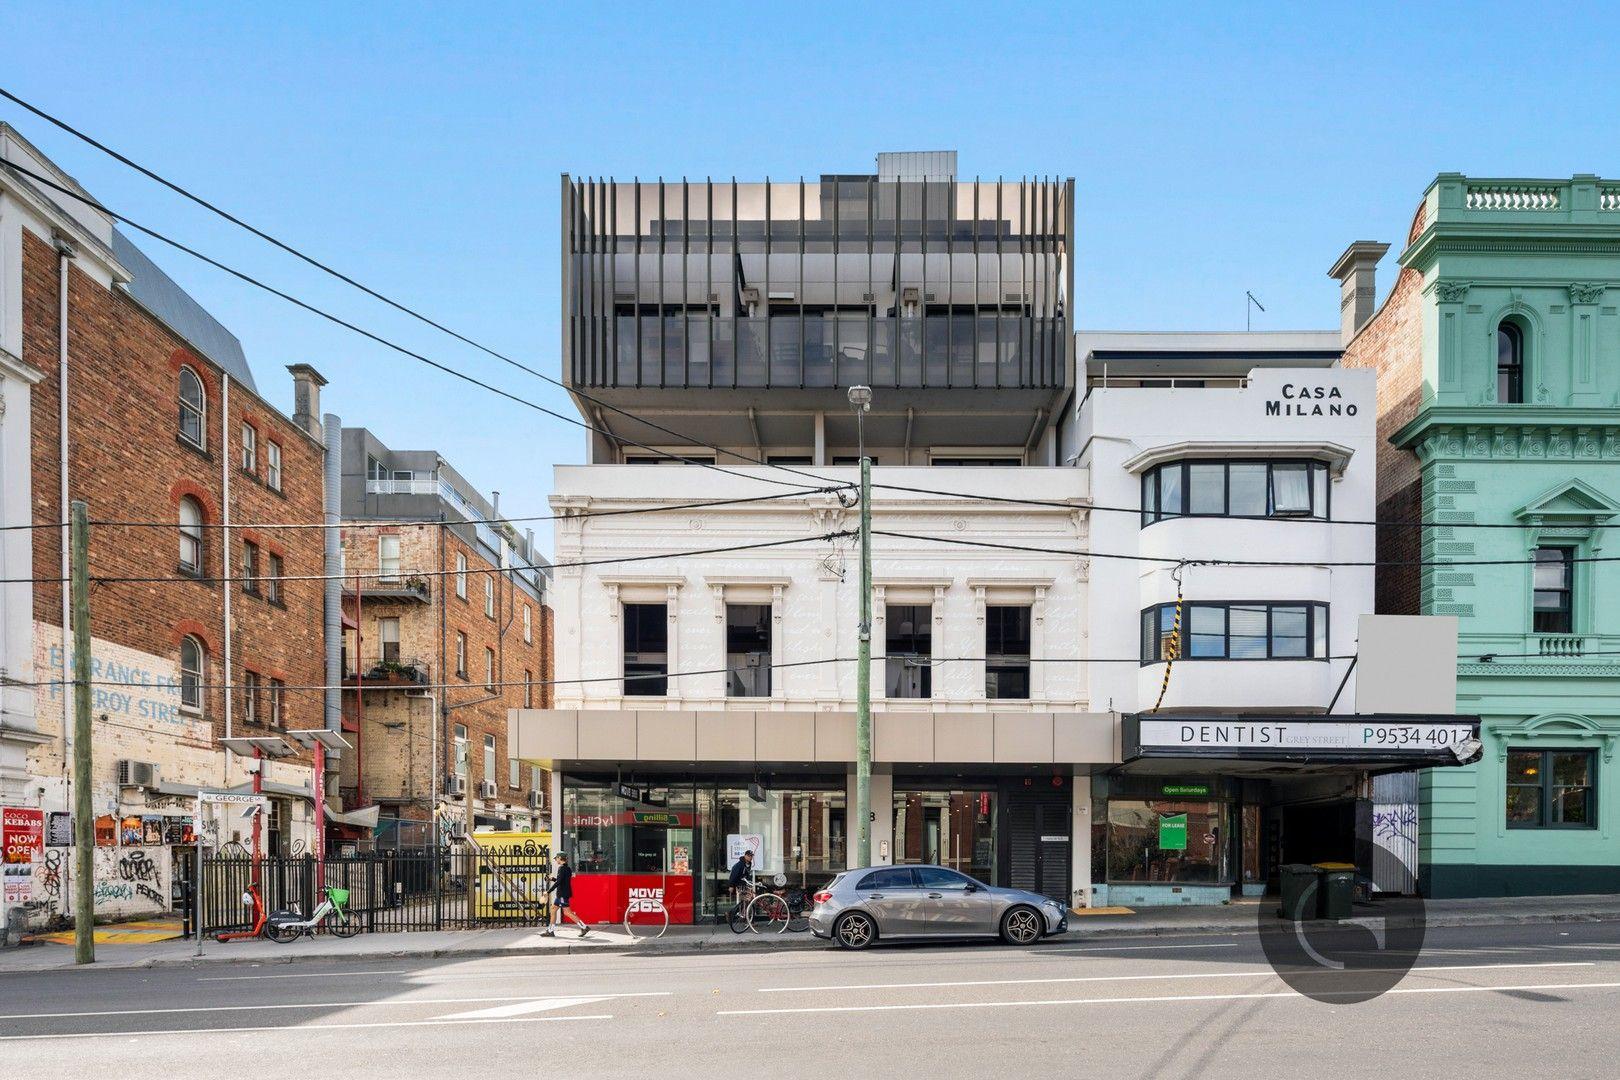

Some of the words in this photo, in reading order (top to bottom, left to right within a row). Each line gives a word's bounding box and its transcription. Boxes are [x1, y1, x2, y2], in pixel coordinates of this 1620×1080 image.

[1281, 383, 1342, 399] CASA
[1265, 400, 1358, 417] MILANO
[1181, 726, 1287, 743] DENTIST
[1286, 735, 1311, 744] GREY
[1312, 736, 1347, 745] STREET
[1180, 786, 1207, 794] Saturdays
[215, 794, 254, 803] GEORGE
[4, 818, 43, 827] KEBABS
[9, 834, 38, 844] NOW
[7, 845, 40, 855] OPEN
[628, 888, 664, 898] MOVE
[628, 899, 664, 913] 365
